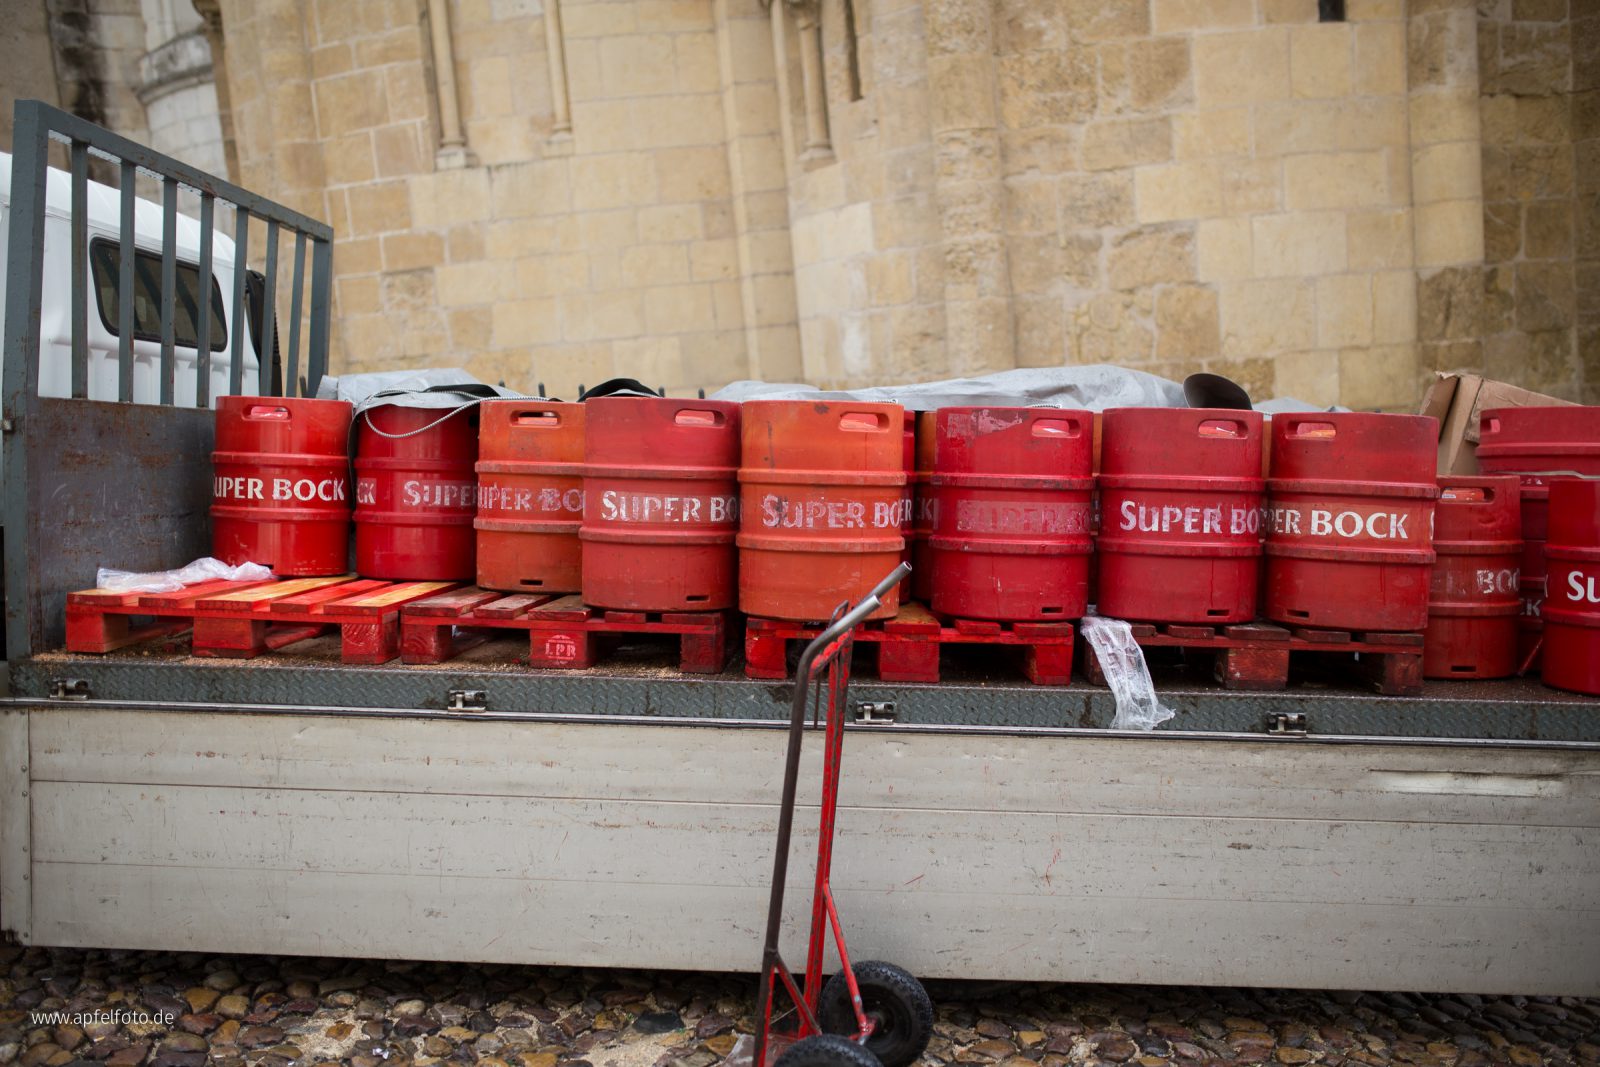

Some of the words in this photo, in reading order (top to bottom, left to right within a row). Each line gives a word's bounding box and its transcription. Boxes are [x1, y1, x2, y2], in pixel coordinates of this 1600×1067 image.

[213, 474, 264, 499] UPER
[273, 478, 345, 501] BOCK
[601, 490, 701, 522] SUPER
[761, 494, 866, 528] SUPER
[1120, 500, 1222, 534] SUPER
[1310, 509, 1408, 539] BOCK
